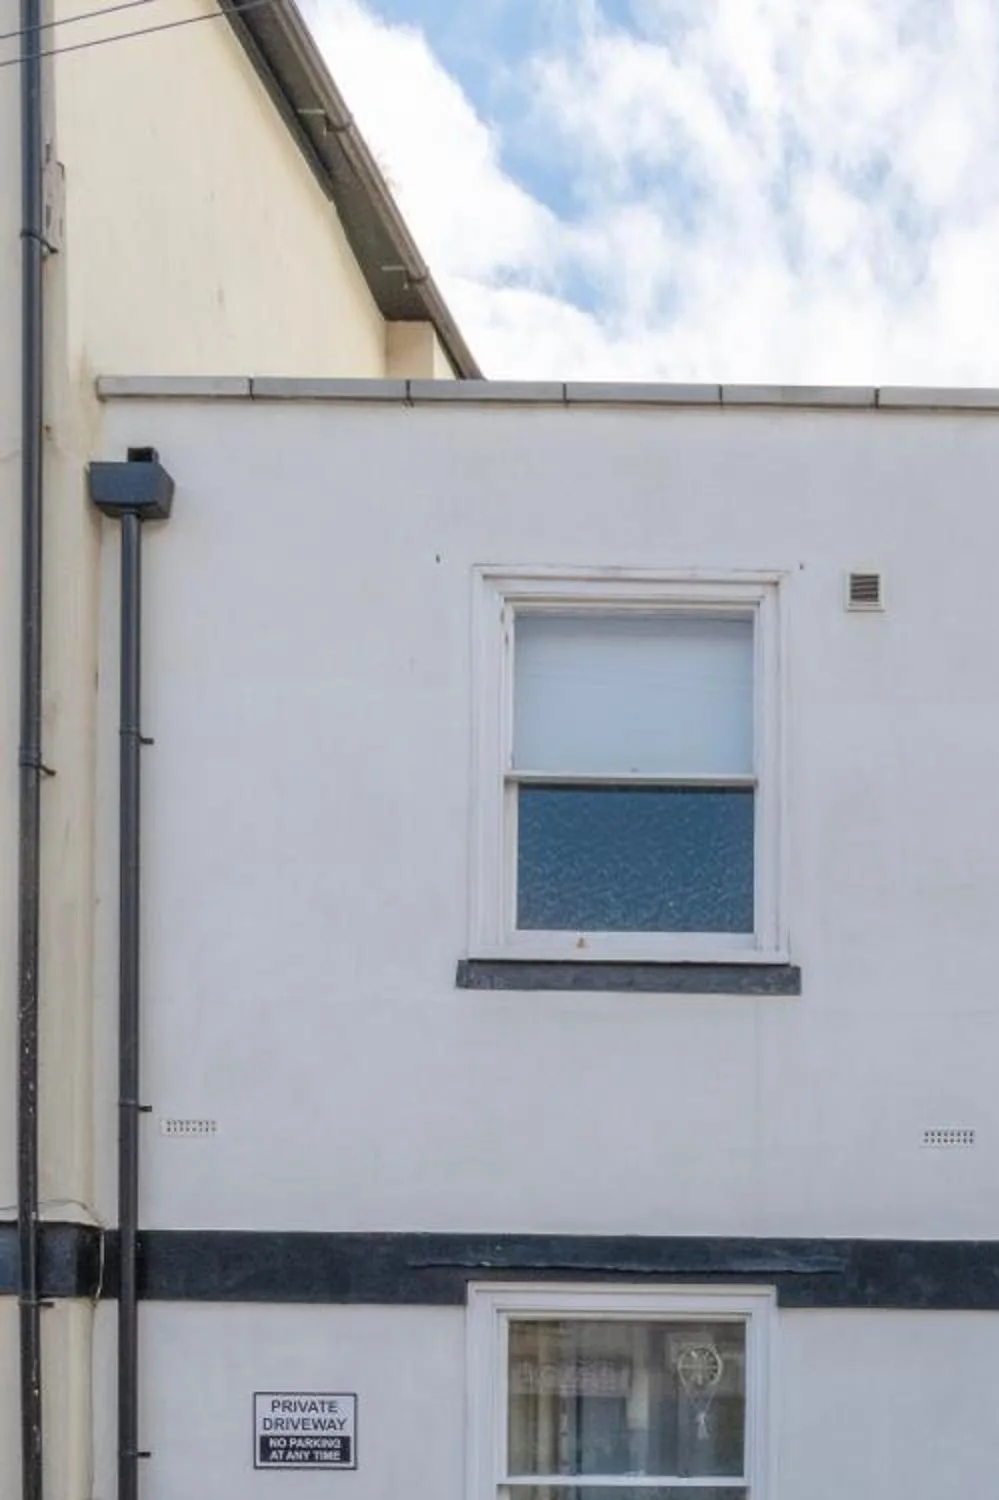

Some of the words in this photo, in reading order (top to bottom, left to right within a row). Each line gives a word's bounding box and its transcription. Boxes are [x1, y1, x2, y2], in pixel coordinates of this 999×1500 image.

[271, 1399, 337, 1412] PRIVATE
[263, 1417, 347, 1431] DRIVEWAY
[269, 1438, 287, 1449] NO
[289, 1438, 342, 1449] PARKING
[270, 1450, 285, 1461] AT
[286, 1450, 311, 1461] ANY
[314, 1450, 341, 1461] TIME
